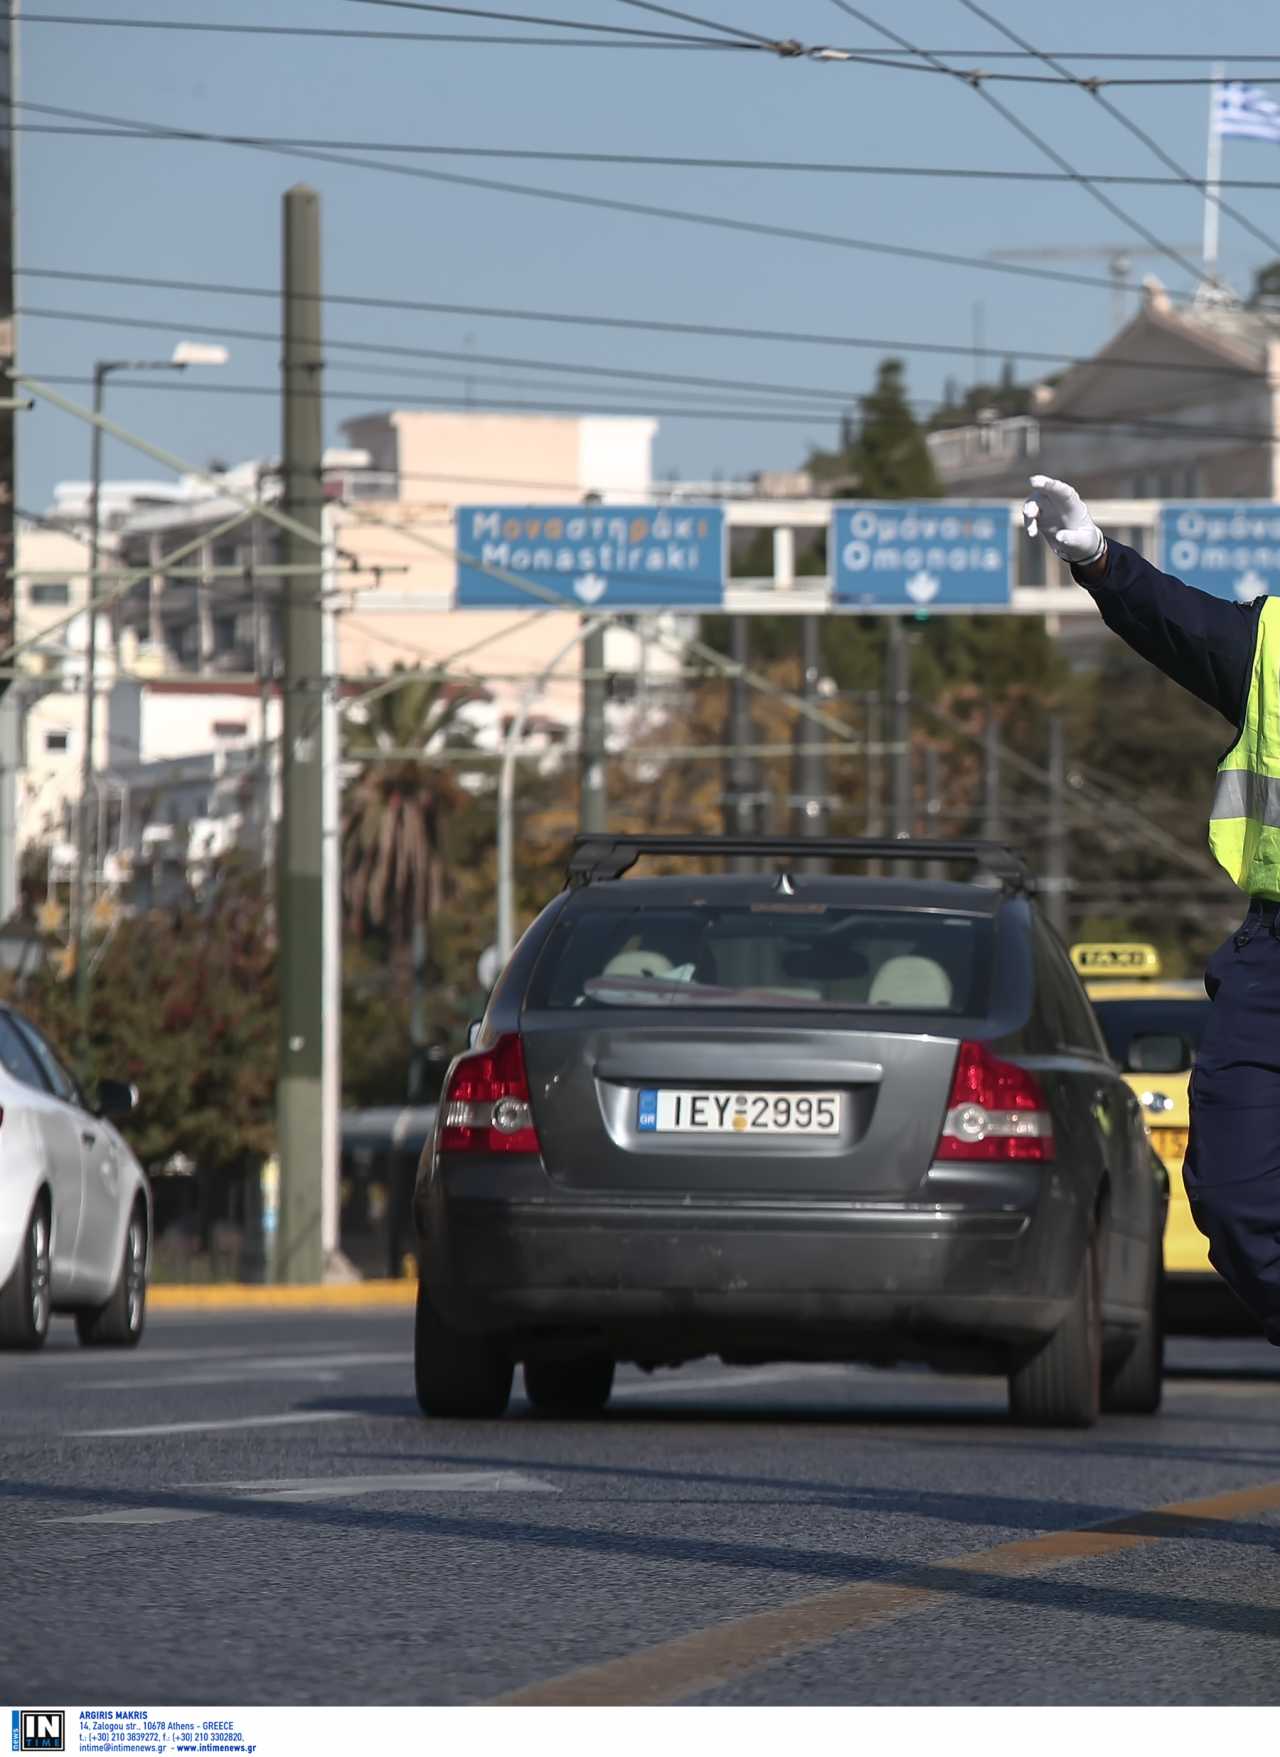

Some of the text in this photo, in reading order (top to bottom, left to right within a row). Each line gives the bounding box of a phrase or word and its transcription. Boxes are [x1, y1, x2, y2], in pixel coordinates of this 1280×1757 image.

[472, 509, 708, 543] Μοναστηράκι
[481, 541, 699, 571] Monastiraki
[843, 540, 1002, 571] Omonoia
